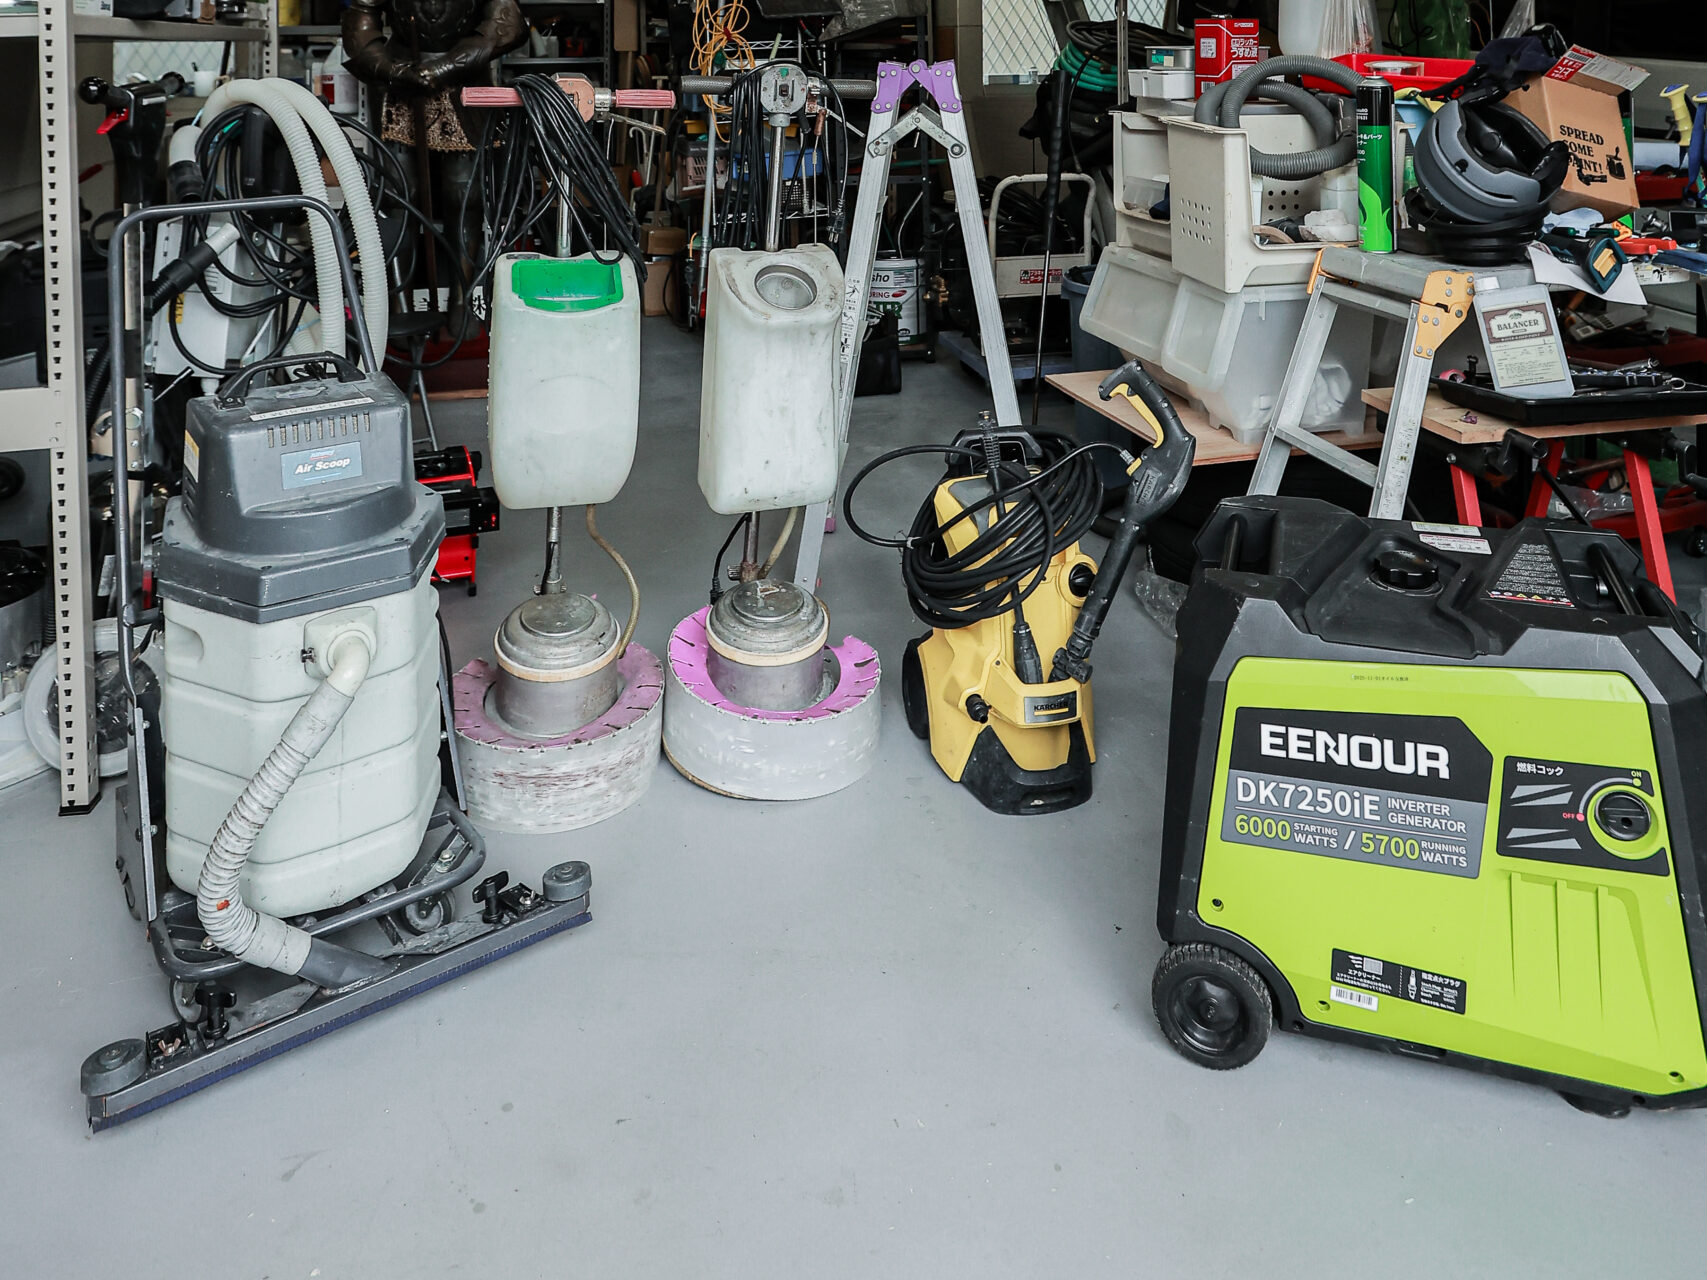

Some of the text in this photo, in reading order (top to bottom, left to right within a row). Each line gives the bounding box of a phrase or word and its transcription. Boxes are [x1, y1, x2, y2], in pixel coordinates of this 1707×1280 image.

[1559, 124, 1605, 146] SPREAD
[1496, 318, 1540, 332] BALANCER
[294, 457, 351, 475] Air Scoop
[1260, 723, 1450, 780] EENOUR
[1516, 761, 1564, 777] 燃料コック
[1630, 770, 1642, 778] ON
[1236, 776, 1451, 821] DK7250iE INVERTER
[1388, 812, 1467, 834] GENERATOR
[1235, 814, 1291, 841] 6000
[1293, 822, 1339, 836] STARTING
[1360, 832, 1420, 861] 5700
[1421, 840, 1467, 855] RUNNING
[1294, 832, 1468, 868] WATTS WATTS
